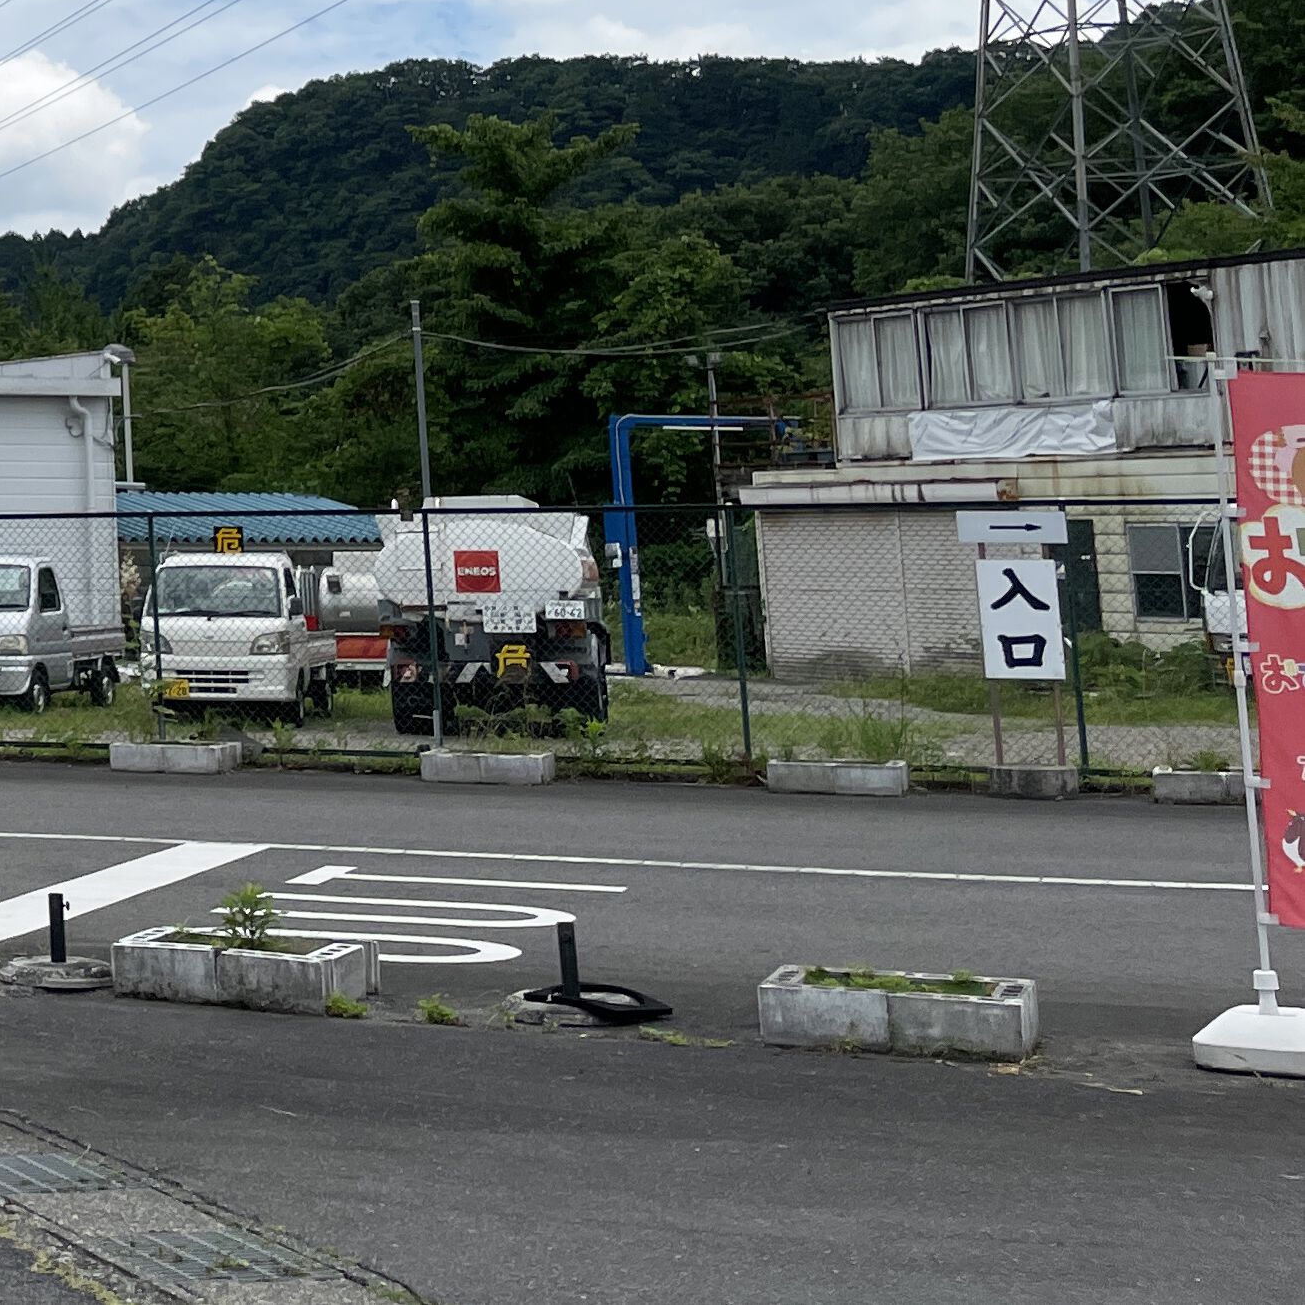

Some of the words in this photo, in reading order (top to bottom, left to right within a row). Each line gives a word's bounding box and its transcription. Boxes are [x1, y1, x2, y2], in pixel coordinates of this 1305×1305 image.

[215, 527, 242, 554] 危
[457, 566, 497, 576] ENEOS
[990, 567, 1051, 670] 入口
